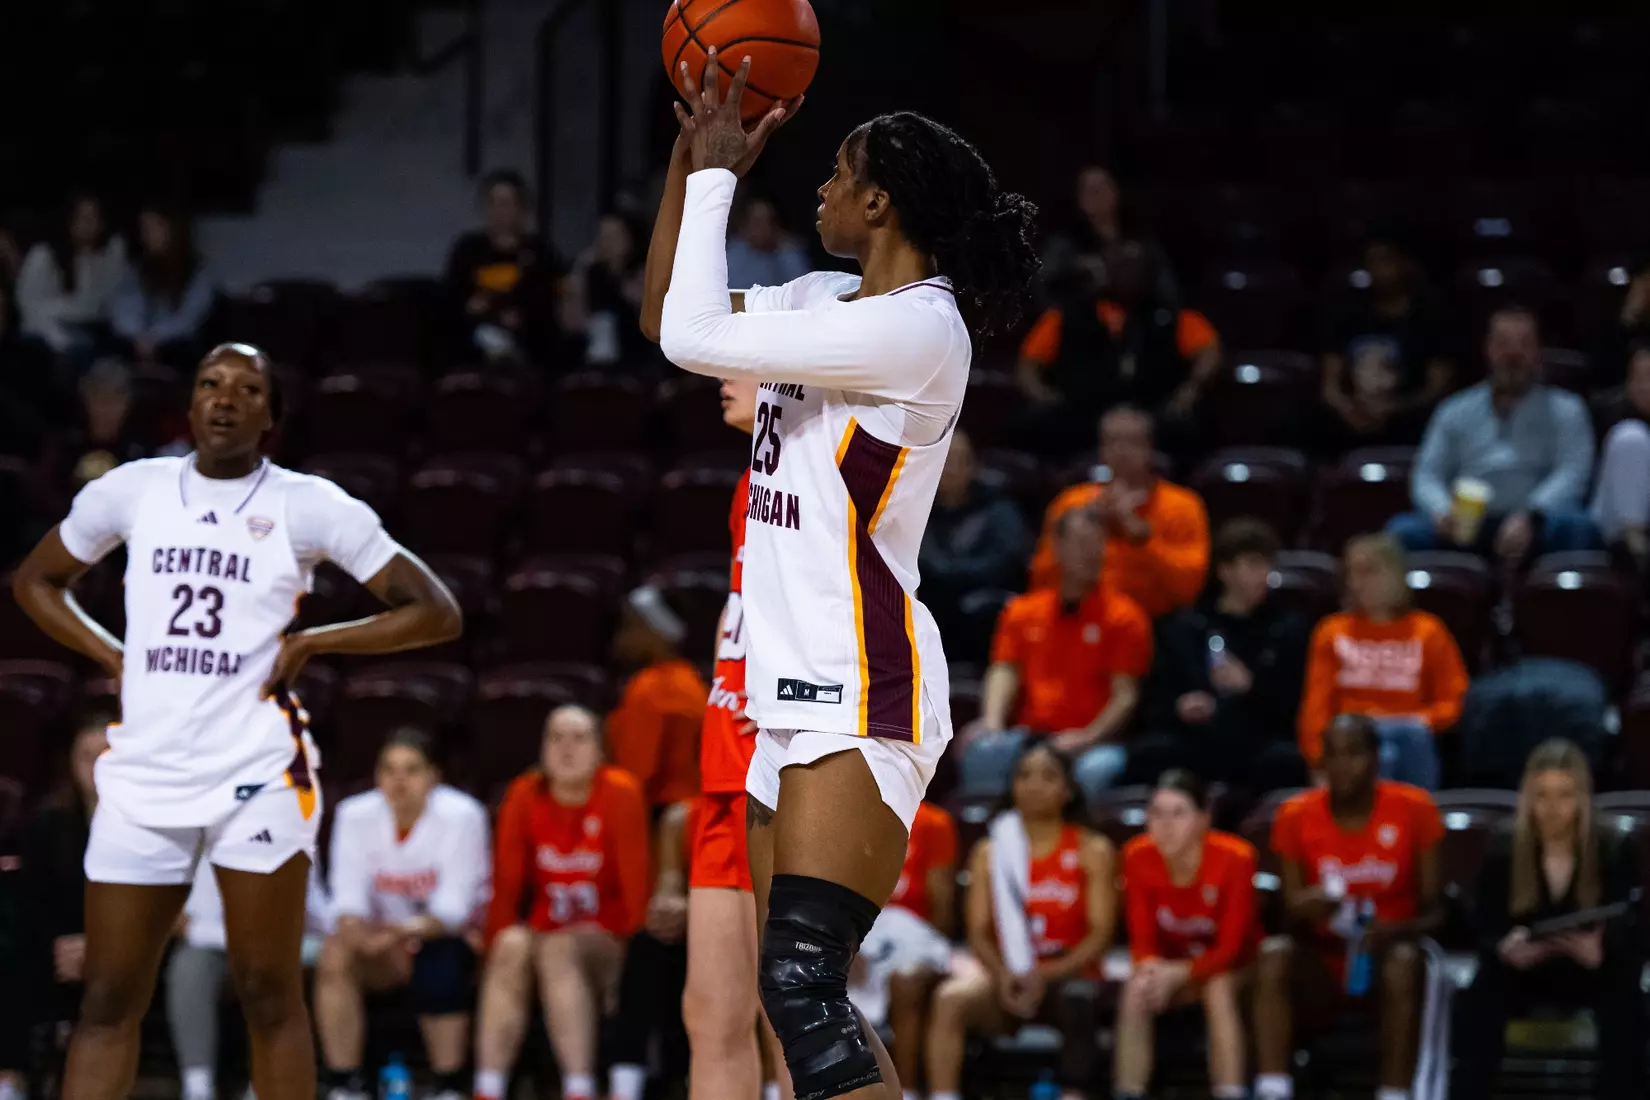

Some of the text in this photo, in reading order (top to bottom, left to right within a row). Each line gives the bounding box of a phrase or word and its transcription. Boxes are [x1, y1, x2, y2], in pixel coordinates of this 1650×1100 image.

[751, 401, 783, 477] 25
[746, 481, 801, 530] CHIGAN
[152, 547, 252, 583] CENTRAL
[167, 584, 225, 639] 23
